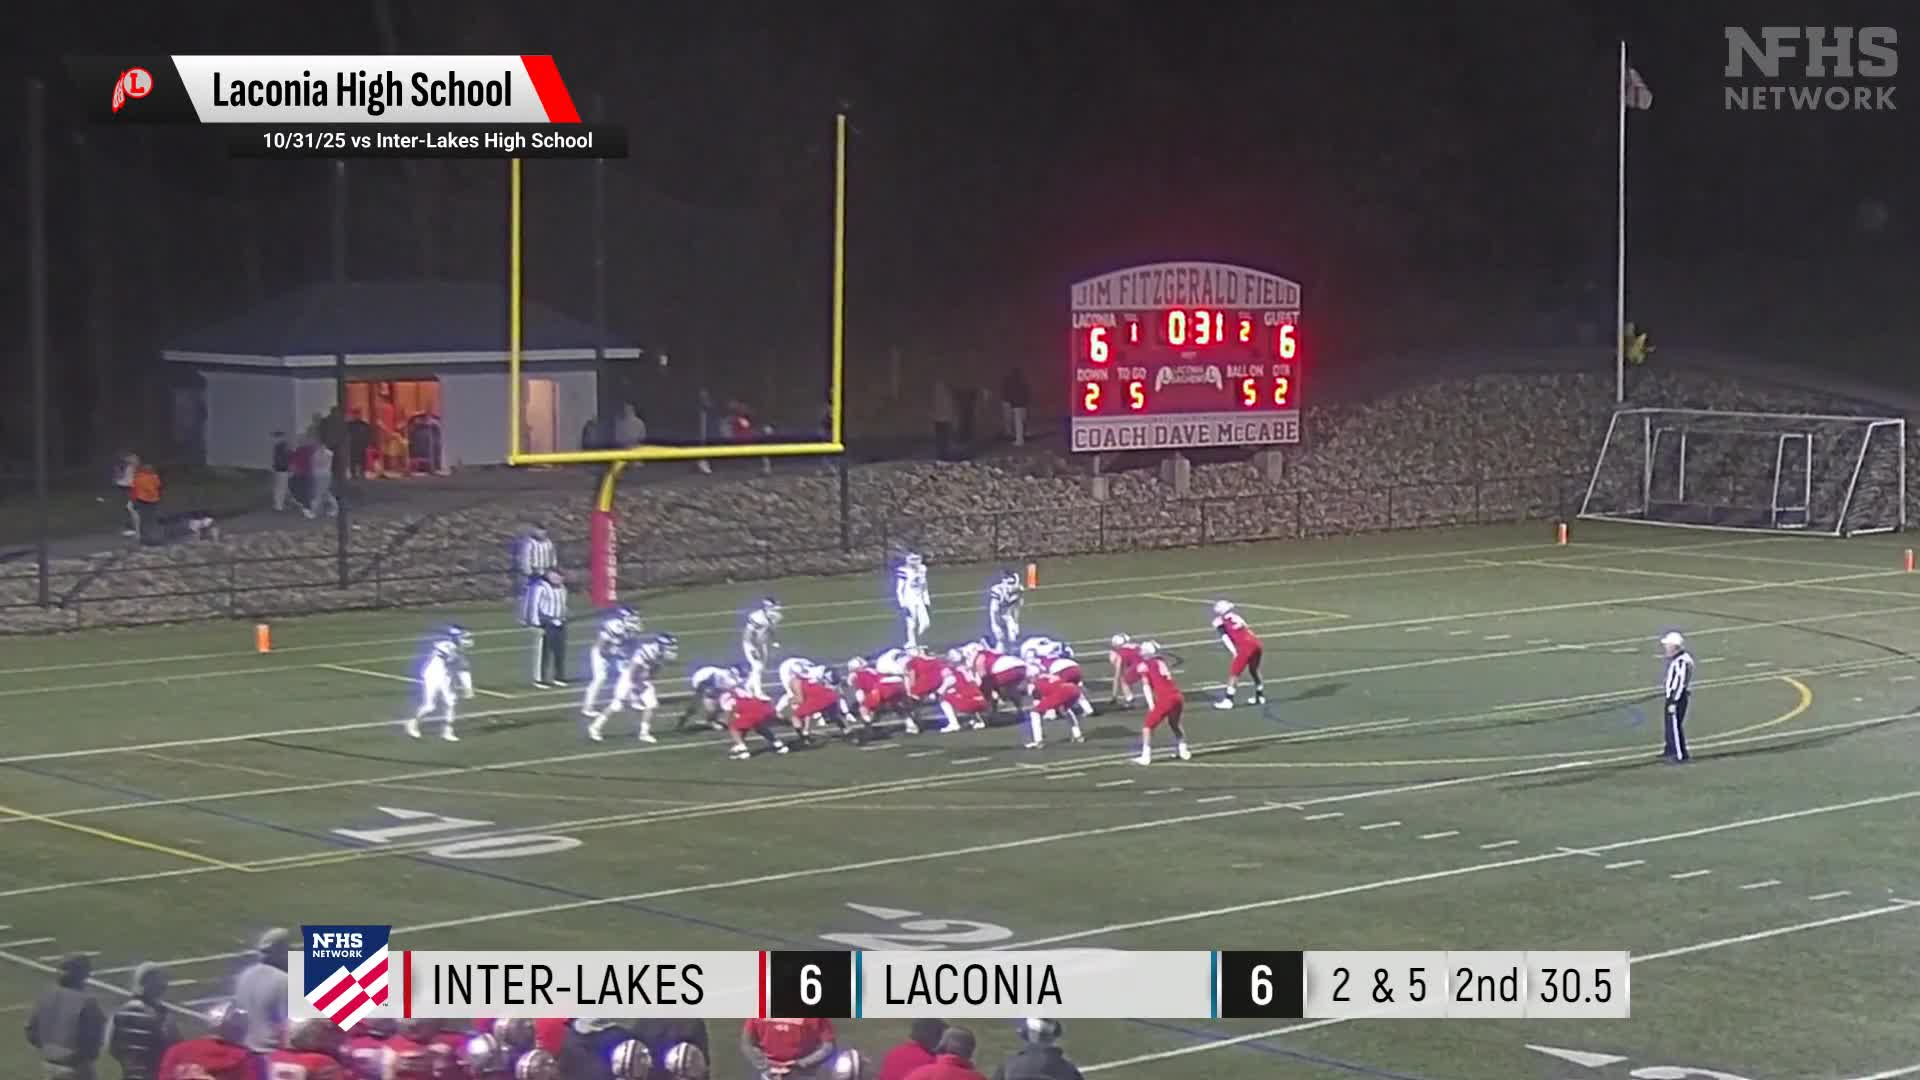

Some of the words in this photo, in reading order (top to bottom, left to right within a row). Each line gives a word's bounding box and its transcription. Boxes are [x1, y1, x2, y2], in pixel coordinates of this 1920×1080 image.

[1076, 279, 1111, 306] JIM
[1119, 267, 1238, 305] FITZGERALD
[1244, 275, 1298, 305] FIELD
[1130, 322, 1138, 343] 1
[1239, 320, 1251, 342] 2
[1263, 312, 1300, 326] GUEST
[1090, 327, 1108, 363] 6
[1279, 325, 1296, 359] 6
[1077, 368, 1109, 381] DOWN
[1117, 367, 1130, 380] TO
[1132, 367, 1147, 380] GO
[1085, 382, 1100, 410] 2
[1129, 381, 1145, 409] 5
[1242, 378, 1256, 406] 5
[1274, 377, 1288, 405] 2
[1074, 427, 1146, 448] COACH
[1154, 423, 1210, 446] DAVE
[1217, 420, 1298, 444] McCABE
